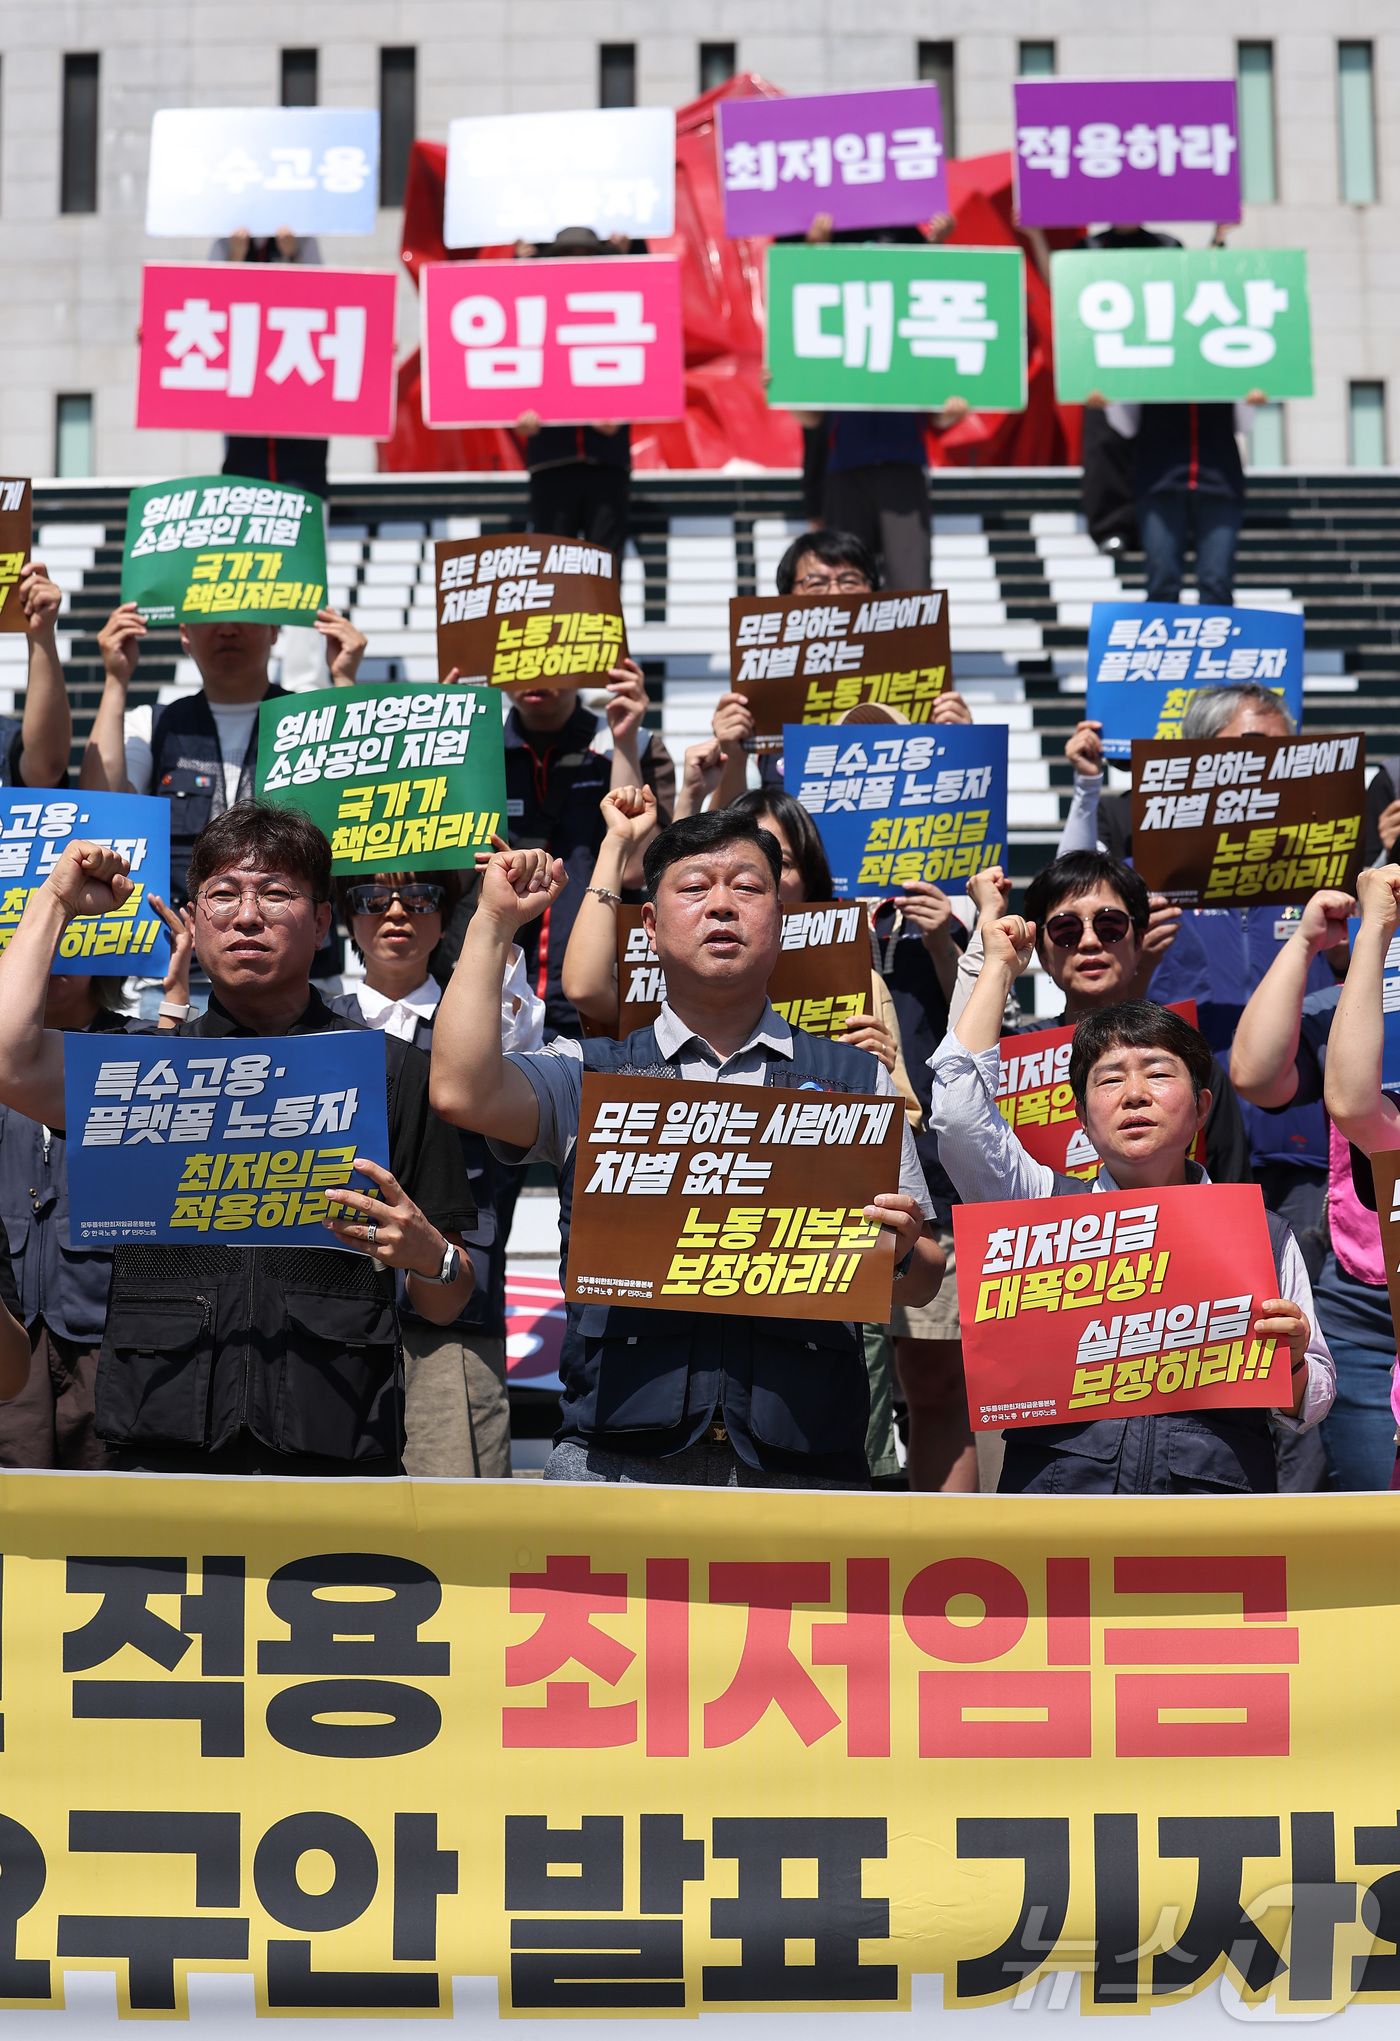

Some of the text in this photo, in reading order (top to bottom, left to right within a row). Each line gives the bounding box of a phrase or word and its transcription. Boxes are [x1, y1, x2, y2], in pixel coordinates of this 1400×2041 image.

[160, 146, 371, 194] 수고용
[725, 127, 942, 191] 최저임금
[1017, 122, 1236, 179] 적용하라
[451, 292, 656, 389] 임금
[792, 280, 998, 376] 대폭
[1078, 279, 1289, 367] 인상
[160, 299, 366, 402] 최저
[140, 485, 313, 528] 영세 자영업자·
[130, 515, 301, 559] 소상공인 지원
[192, 551, 283, 582] 국가가
[439, 544, 613, 591] 모든 일하는 사람에게
[182, 581, 324, 614] 책임져라!!
[440, 578, 555, 626] 차별 없는
[736, 593, 943, 647] 모든 일하는 사람에게
[495, 612, 623, 651] 노동기본권
[1107, 616, 1242, 650] 특수고용·
[491, 643, 619, 685] 보장하라!!
[736, 639, 865, 682] 차별 없는
[1096, 648, 1288, 682] 플랫폼 노동자
[804, 665, 946, 712] 노동기본권
[273, 692, 486, 753] 영세 자영업자·
[263, 729, 470, 793] 소상공인 지원
[804, 736, 946, 778] 특수고용·
[1138, 736, 1360, 793] 모든 일하는 사람에게
[338, 776, 448, 822] 국가가
[797, 765, 993, 814] 플랫폼 노동자
[1139, 787, 1281, 831] 차별 없는
[0, 802, 90, 840] 고용·
[331, 811, 500, 863] 책임져라!!
[864, 809, 990, 853] 최저임금
[1212, 815, 1362, 865] 노동기본권
[857, 843, 1002, 887] 적용하라!!
[1203, 853, 1350, 899] 보장하라!!
[780, 906, 861, 952] 람에게
[94, 1054, 286, 1102] 특수고용·
[81, 1087, 359, 1147] 플랫폼 노동자
[587, 1100, 896, 1147] 모든 일하는 사람에게
[177, 1145, 357, 1192] 최저임금
[583, 1150, 773, 1196] 차별 없는
[675, 1206, 883, 1250] 노동기본권
[981, 1203, 1160, 1275] 최저임금
[660, 1251, 863, 1297] 보장하라!!
[974, 1250, 1171, 1324] 대폭인상!
[1075, 1294, 1254, 1366] 실질임금
[1068, 1337, 1278, 1411] 보장하라!!
[62, 1552, 450, 1759] 적용
[502, 1555, 1300, 1758] 최저임금
[0, 1809, 1400, 2009] 구안 발표 기자
